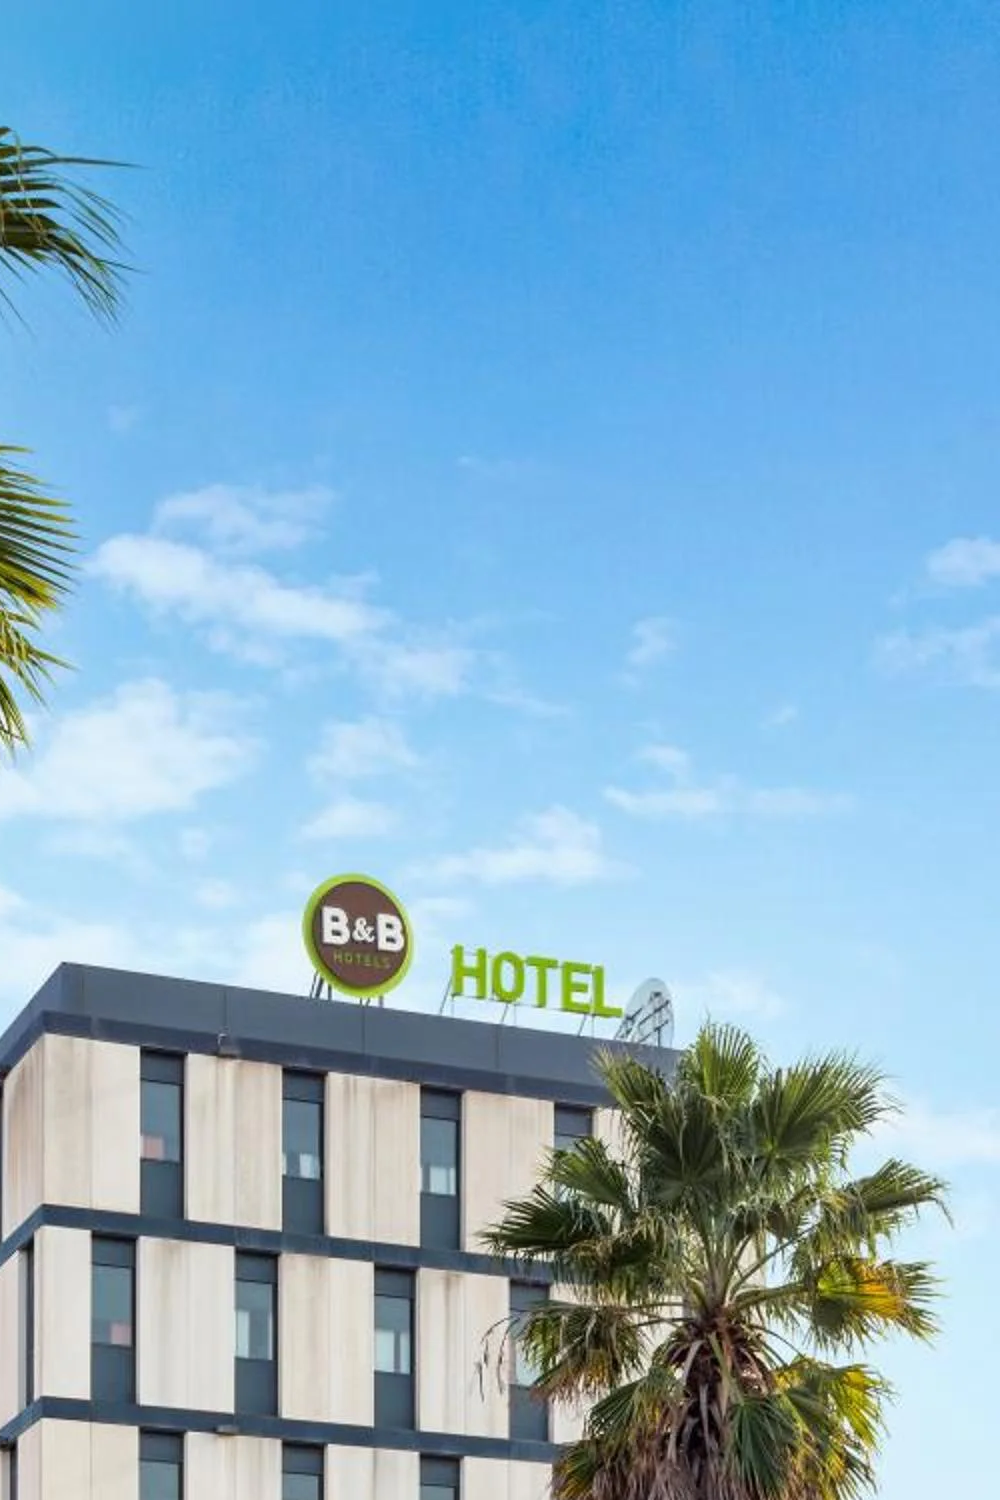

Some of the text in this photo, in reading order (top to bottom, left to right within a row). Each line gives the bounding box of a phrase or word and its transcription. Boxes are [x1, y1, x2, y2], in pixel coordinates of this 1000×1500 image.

[322, 906, 405, 952] B&B
[333, 950, 391, 969] HOTELS
[452, 943, 624, 1018] HOTEL
